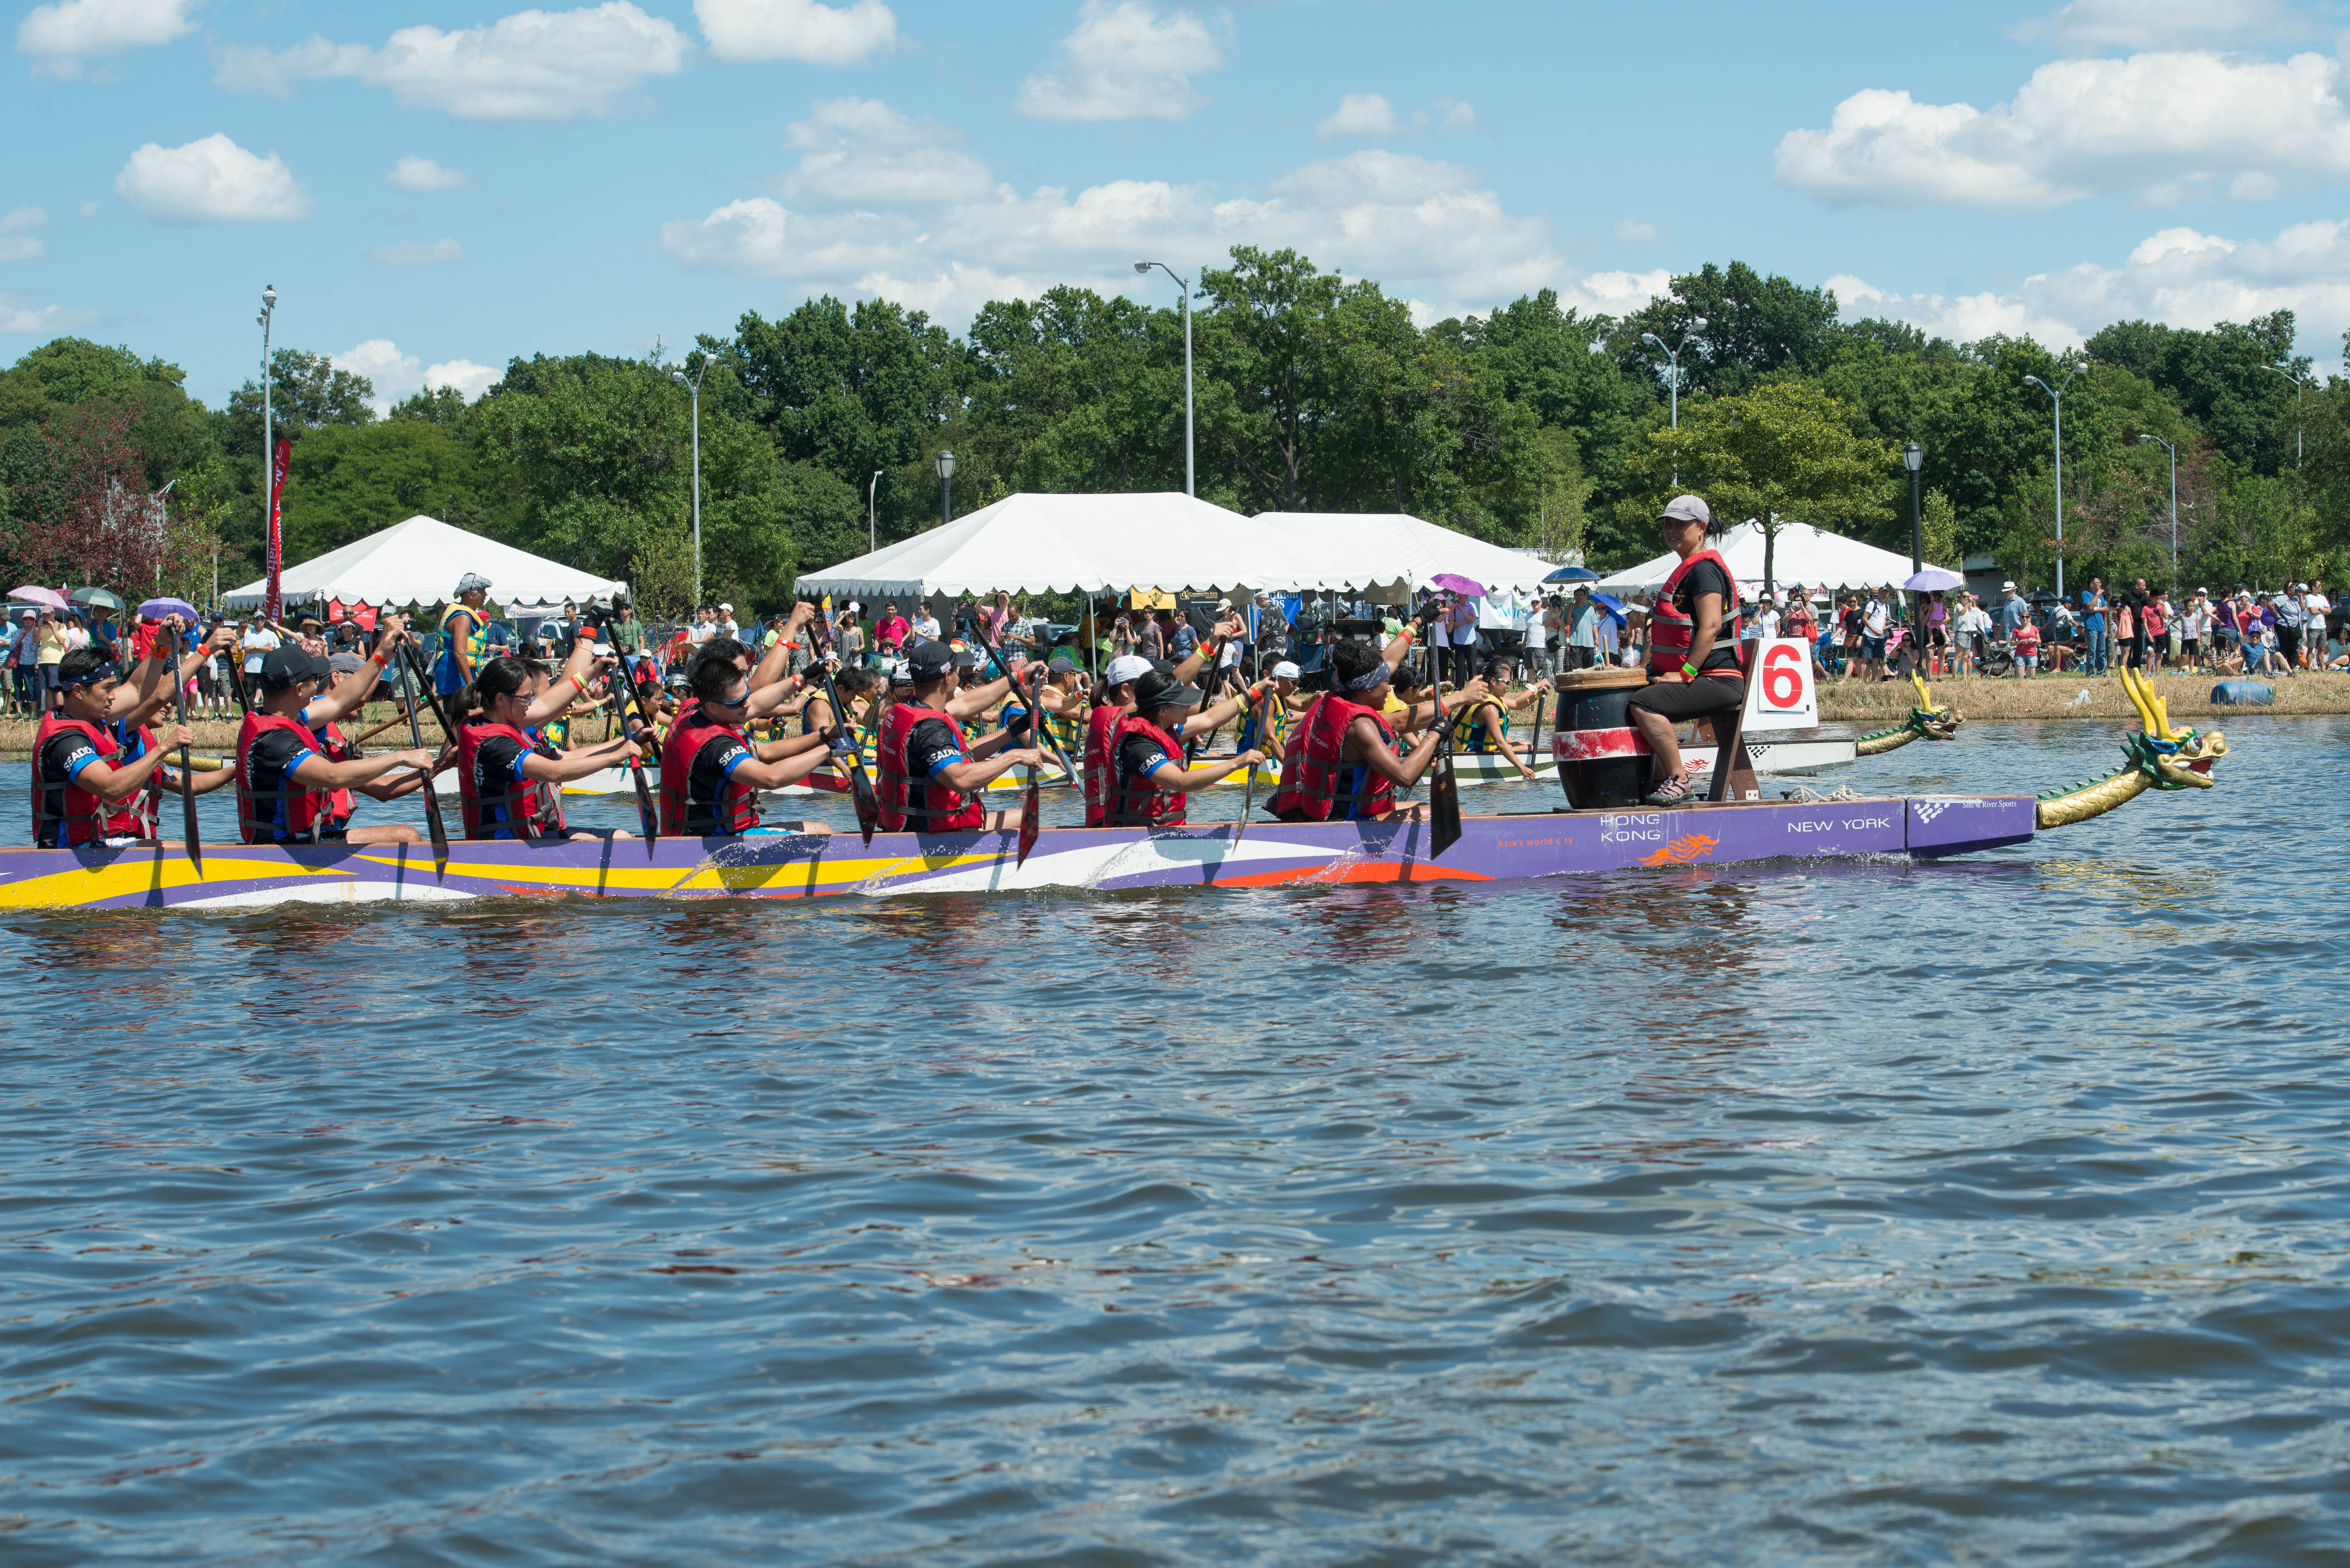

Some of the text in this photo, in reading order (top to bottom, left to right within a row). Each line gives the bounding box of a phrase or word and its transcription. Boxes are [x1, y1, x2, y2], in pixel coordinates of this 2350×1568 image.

[1763, 644, 1803, 708] 6
[1999, 800, 2017, 809] Sports
[1600, 814, 1660, 826] HONG
[1788, 817, 1891, 833] NEW YORK
[1601, 830, 1661, 842] KONG
[1498, 838, 1524, 848] Asia's
[1526, 837, 1553, 846] world
